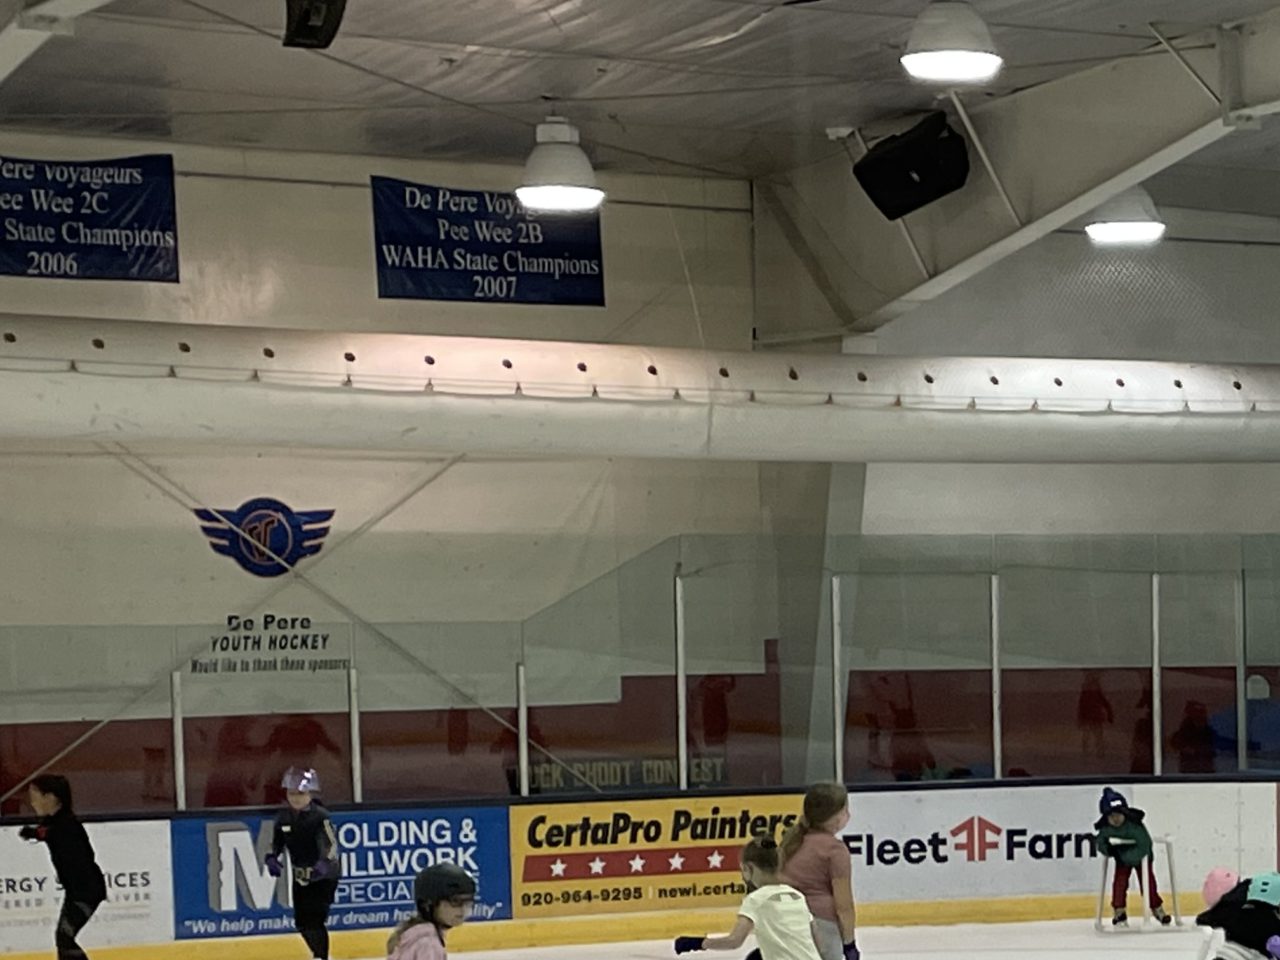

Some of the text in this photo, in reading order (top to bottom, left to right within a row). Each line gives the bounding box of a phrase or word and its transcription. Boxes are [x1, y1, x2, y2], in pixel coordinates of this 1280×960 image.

[0, 158, 35, 180] ere
[0, 188, 110, 214] ee Wee 2C
[404, 186, 431, 209] De
[437, 190, 479, 213] Pere
[4, 217, 174, 251] State Champions
[438, 218, 544, 244] Pee Wee 2B
[27, 251, 78, 275] 2006
[382, 244, 600, 280] WAHA State Champions
[473, 275, 518, 297] 2007
[227, 614, 312, 631] De Pere
[211, 634, 329, 652] YOUTH HOCKEY
[516, 762, 565, 788] UCK
[642, 757, 725, 784] CONEST
[336, 818, 478, 849] OLDING &
[527, 807, 798, 848] CertaPro Painters
[338, 846, 480, 877] ILLWORK
[842, 831, 949, 866] Fleet
[0, 871, 151, 894] RGY SICES
[521, 882, 747, 906] 920-964-9295 newi.certa
[221, 915, 254, 934] help
[343, 909, 389, 926] dream
